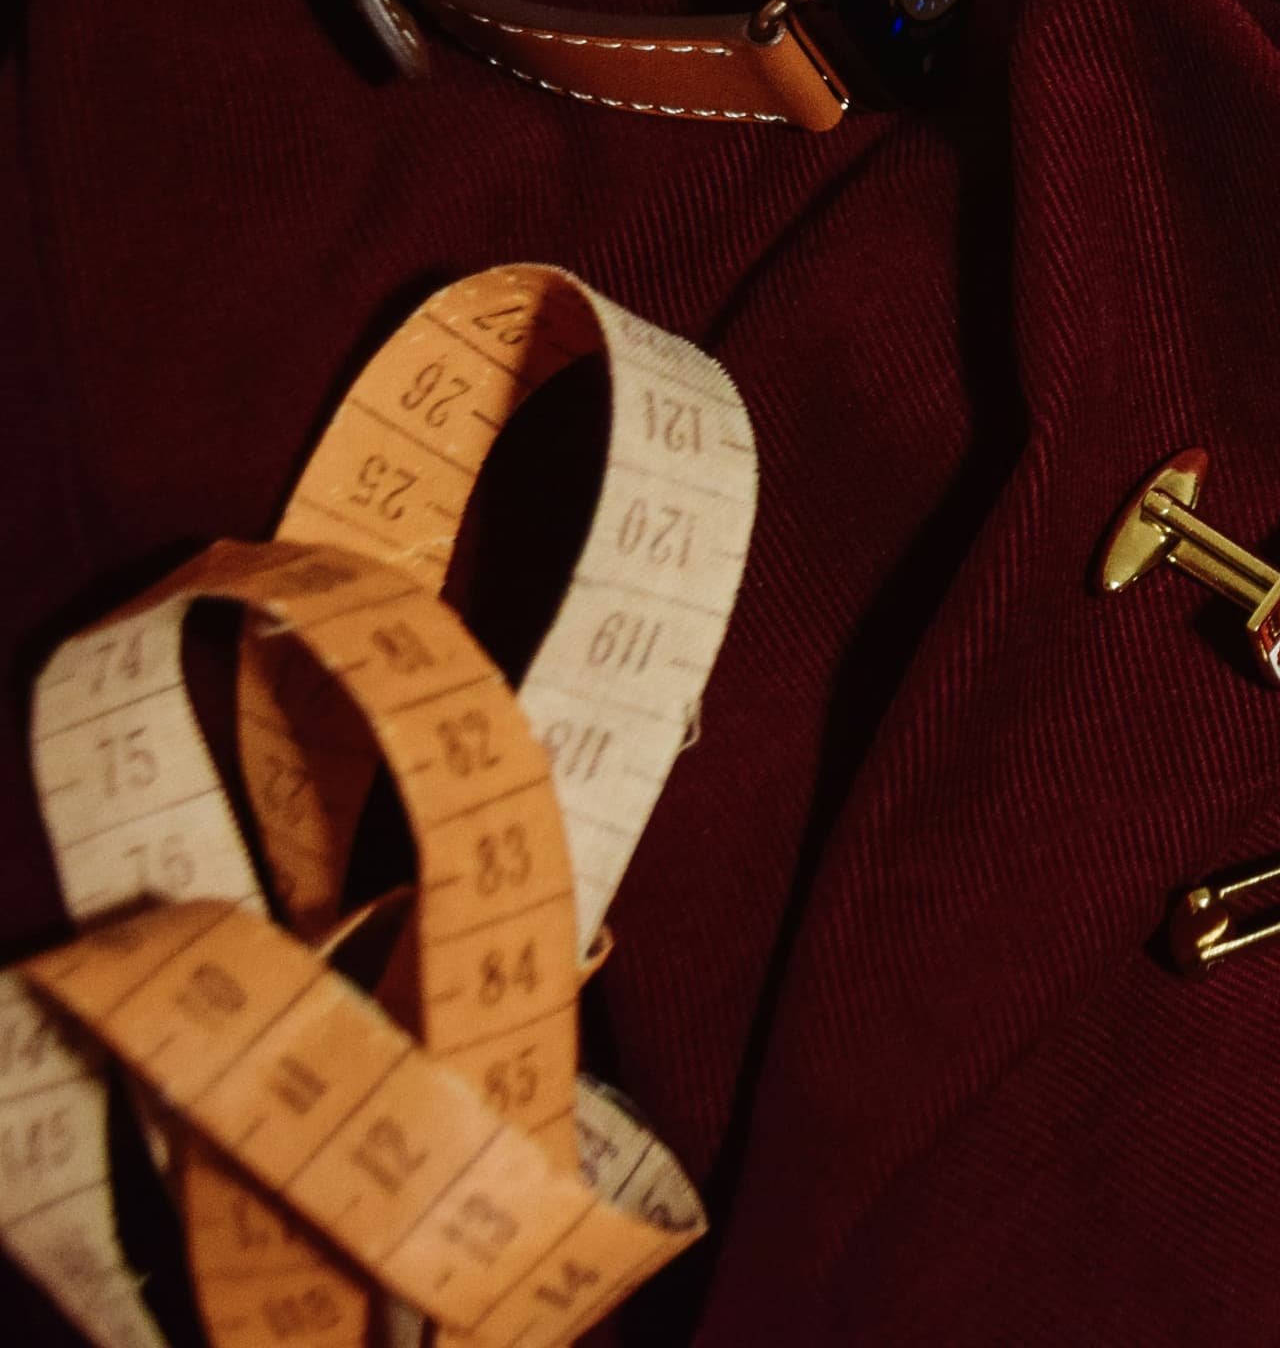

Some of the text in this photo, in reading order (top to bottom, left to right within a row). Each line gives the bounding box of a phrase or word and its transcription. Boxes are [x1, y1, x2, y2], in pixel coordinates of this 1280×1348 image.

[400, 360, 470, 428] 26
[642, 393, 705, 452] 121
[353, 453, 418, 522] 25
[616, 499, 695, 564] 120
[588, 611, 664, 674] 119
[474, 828, 532, 894] 83
[478, 941, 538, 1004] 84
